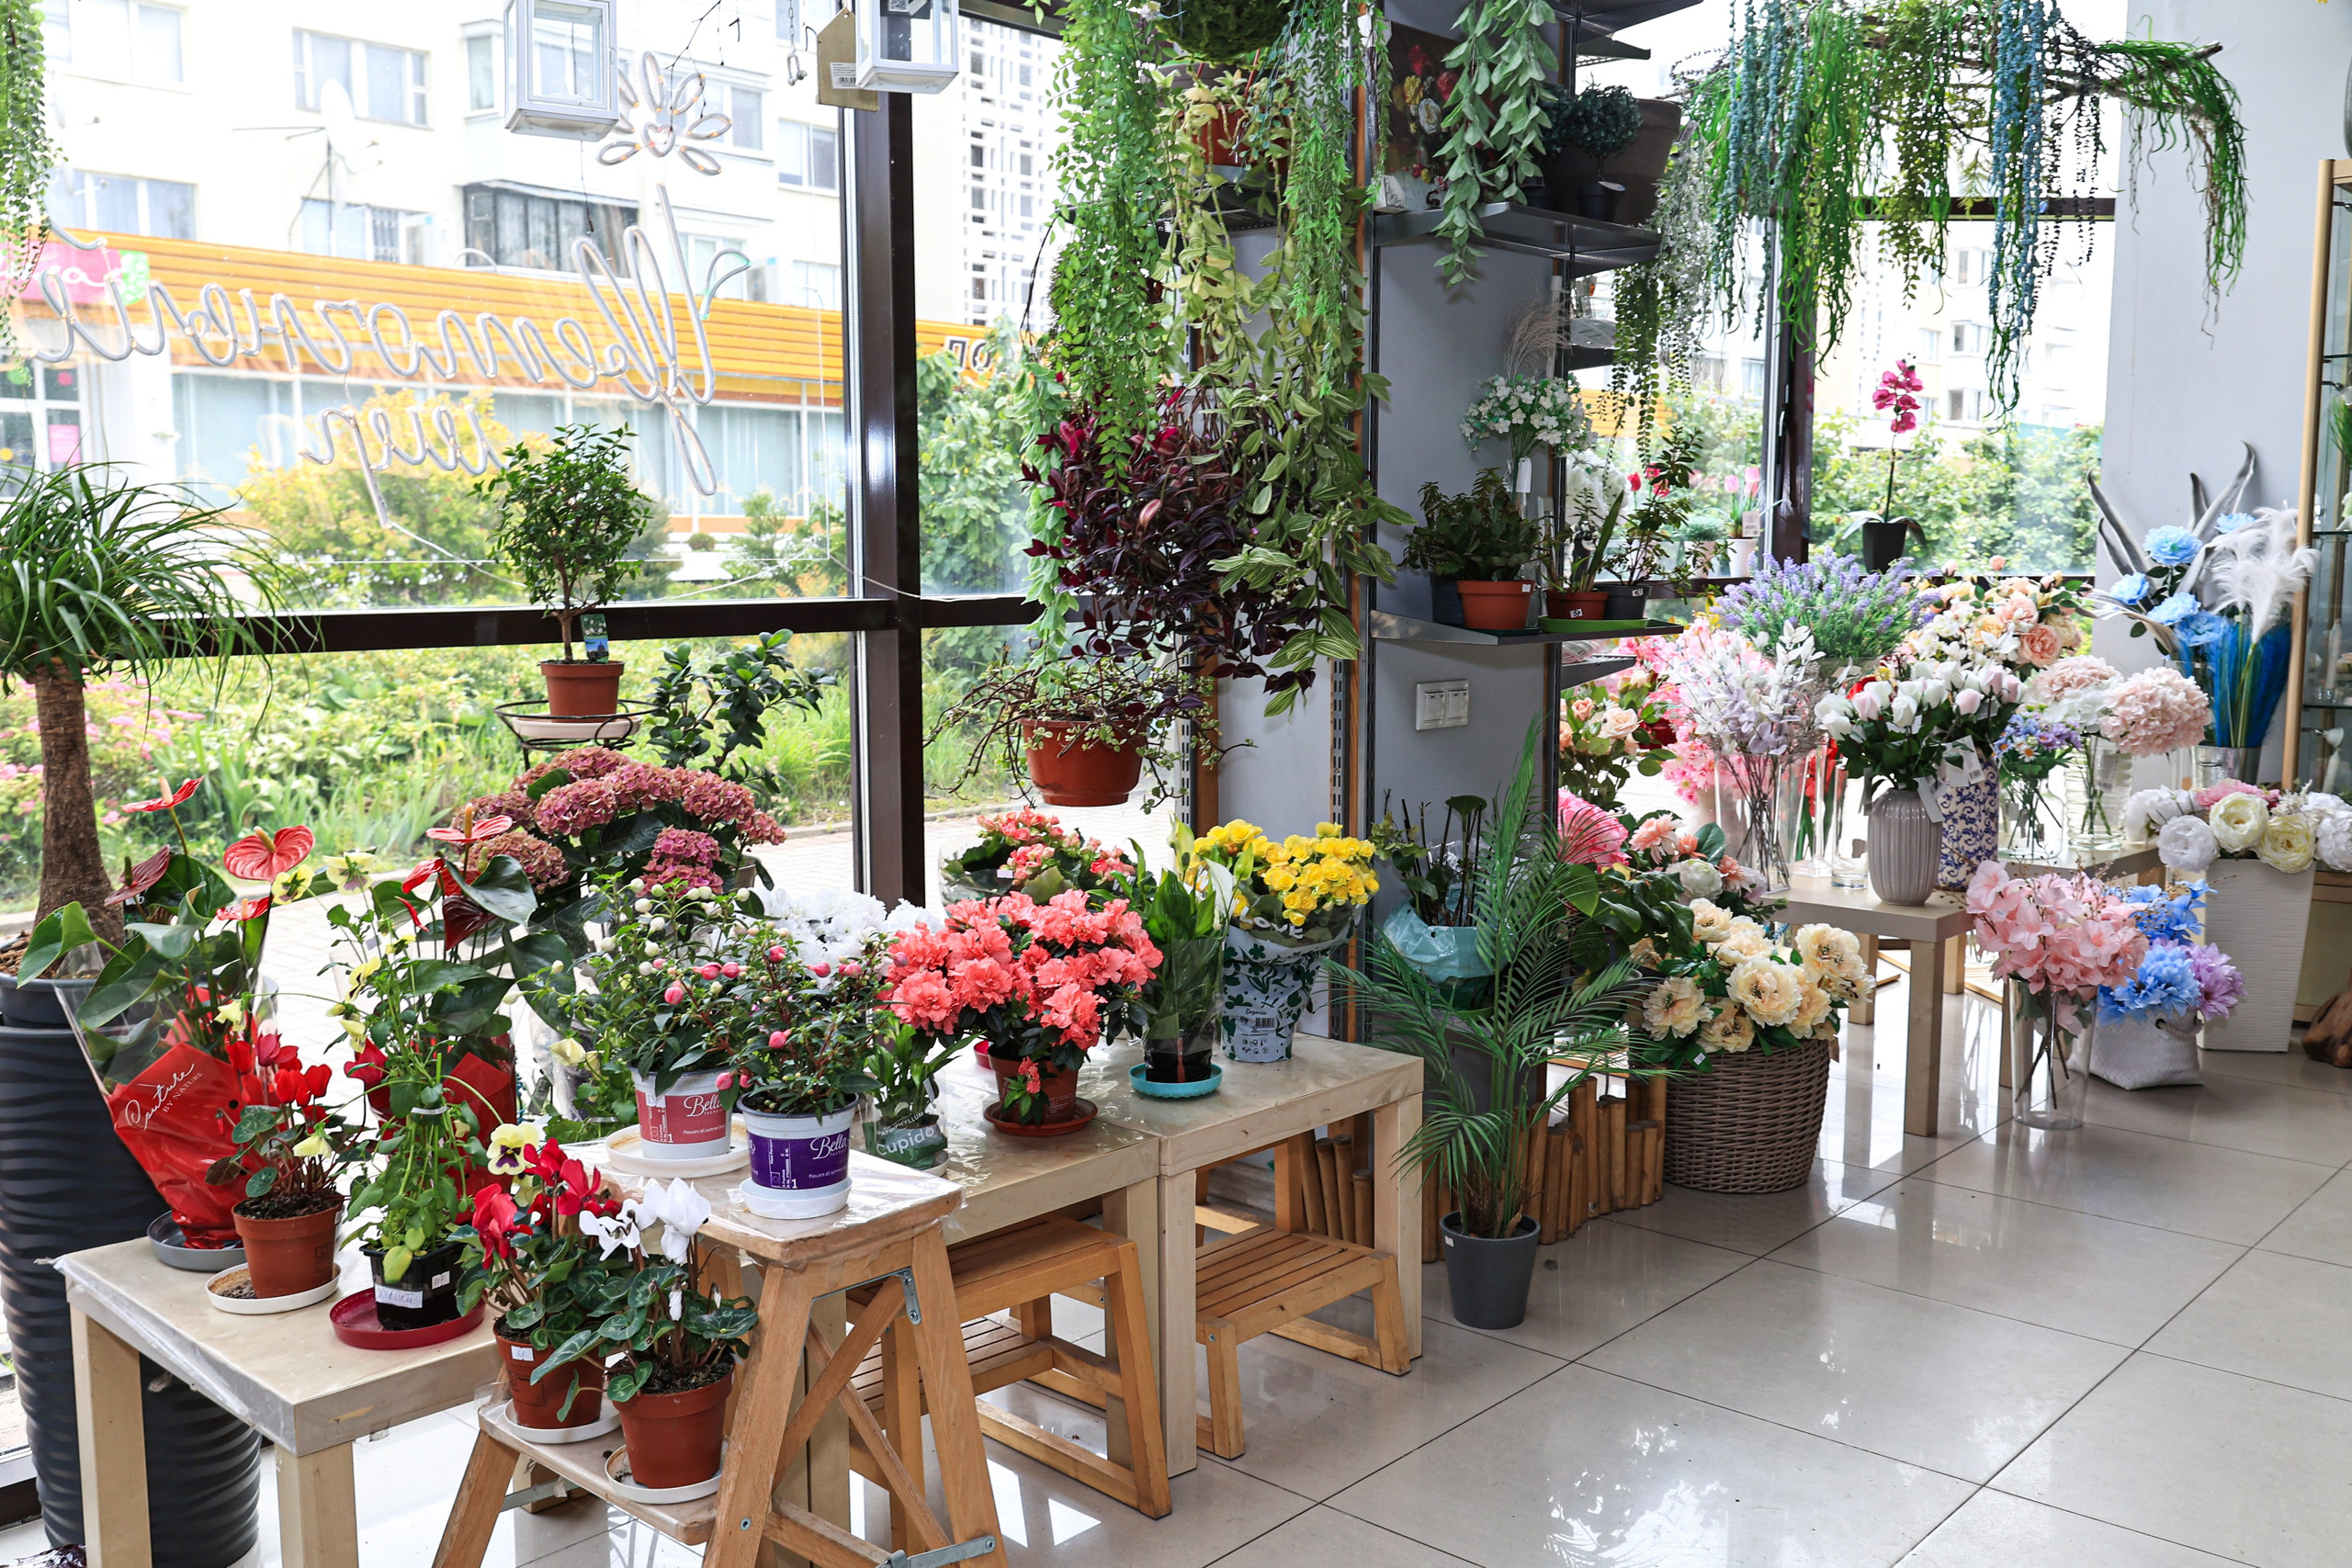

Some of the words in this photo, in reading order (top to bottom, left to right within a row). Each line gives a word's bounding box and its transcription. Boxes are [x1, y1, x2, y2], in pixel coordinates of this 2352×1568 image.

[1246, 1008, 1267, 1016] Begonia
[163, 1100, 173, 1112] BY
[173, 1072, 204, 1100] NATURE
[667, 1134, 673, 1143] 1
[809, 1134, 847, 1159] Bella
[876, 1127, 934, 1156] Cupido
[791, 1179, 797, 1189] 1
